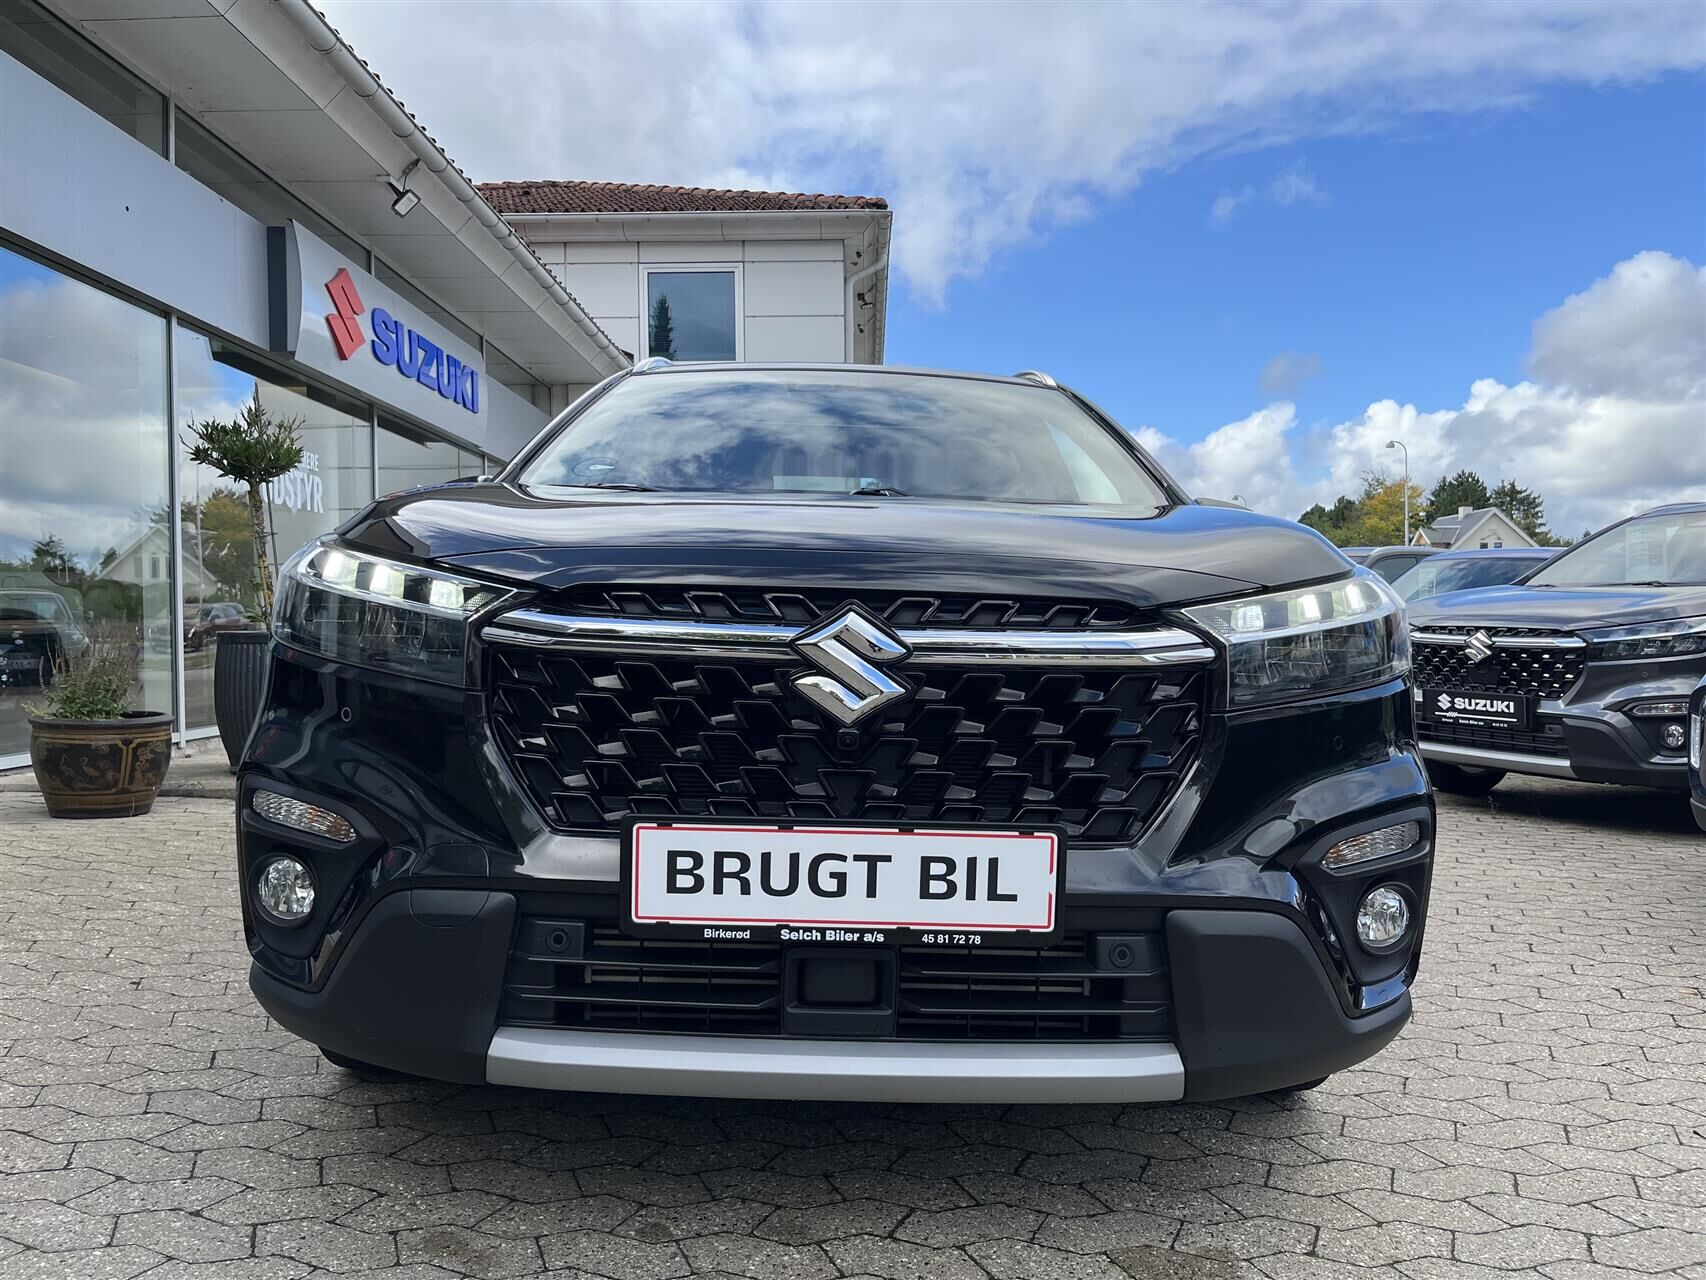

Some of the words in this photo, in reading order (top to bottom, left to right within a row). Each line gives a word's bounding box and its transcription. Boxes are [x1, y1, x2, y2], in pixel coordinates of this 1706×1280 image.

[371, 309, 478, 414] SUZUKI
[1454, 698, 1515, 713] SUZUKI
[666, 849, 893, 899] BRUGT
[919, 855, 1018, 902] BIL
[703, 927, 751, 940] Birkerød
[780, 928, 822, 941] Selch
[825, 929, 861, 942] Biler
[863, 930, 885, 944] a/s
[921, 933, 935, 945] 45
[936, 933, 949, 945] 81
[952, 933, 966, 945] 72
[967, 933, 982, 946] 78
